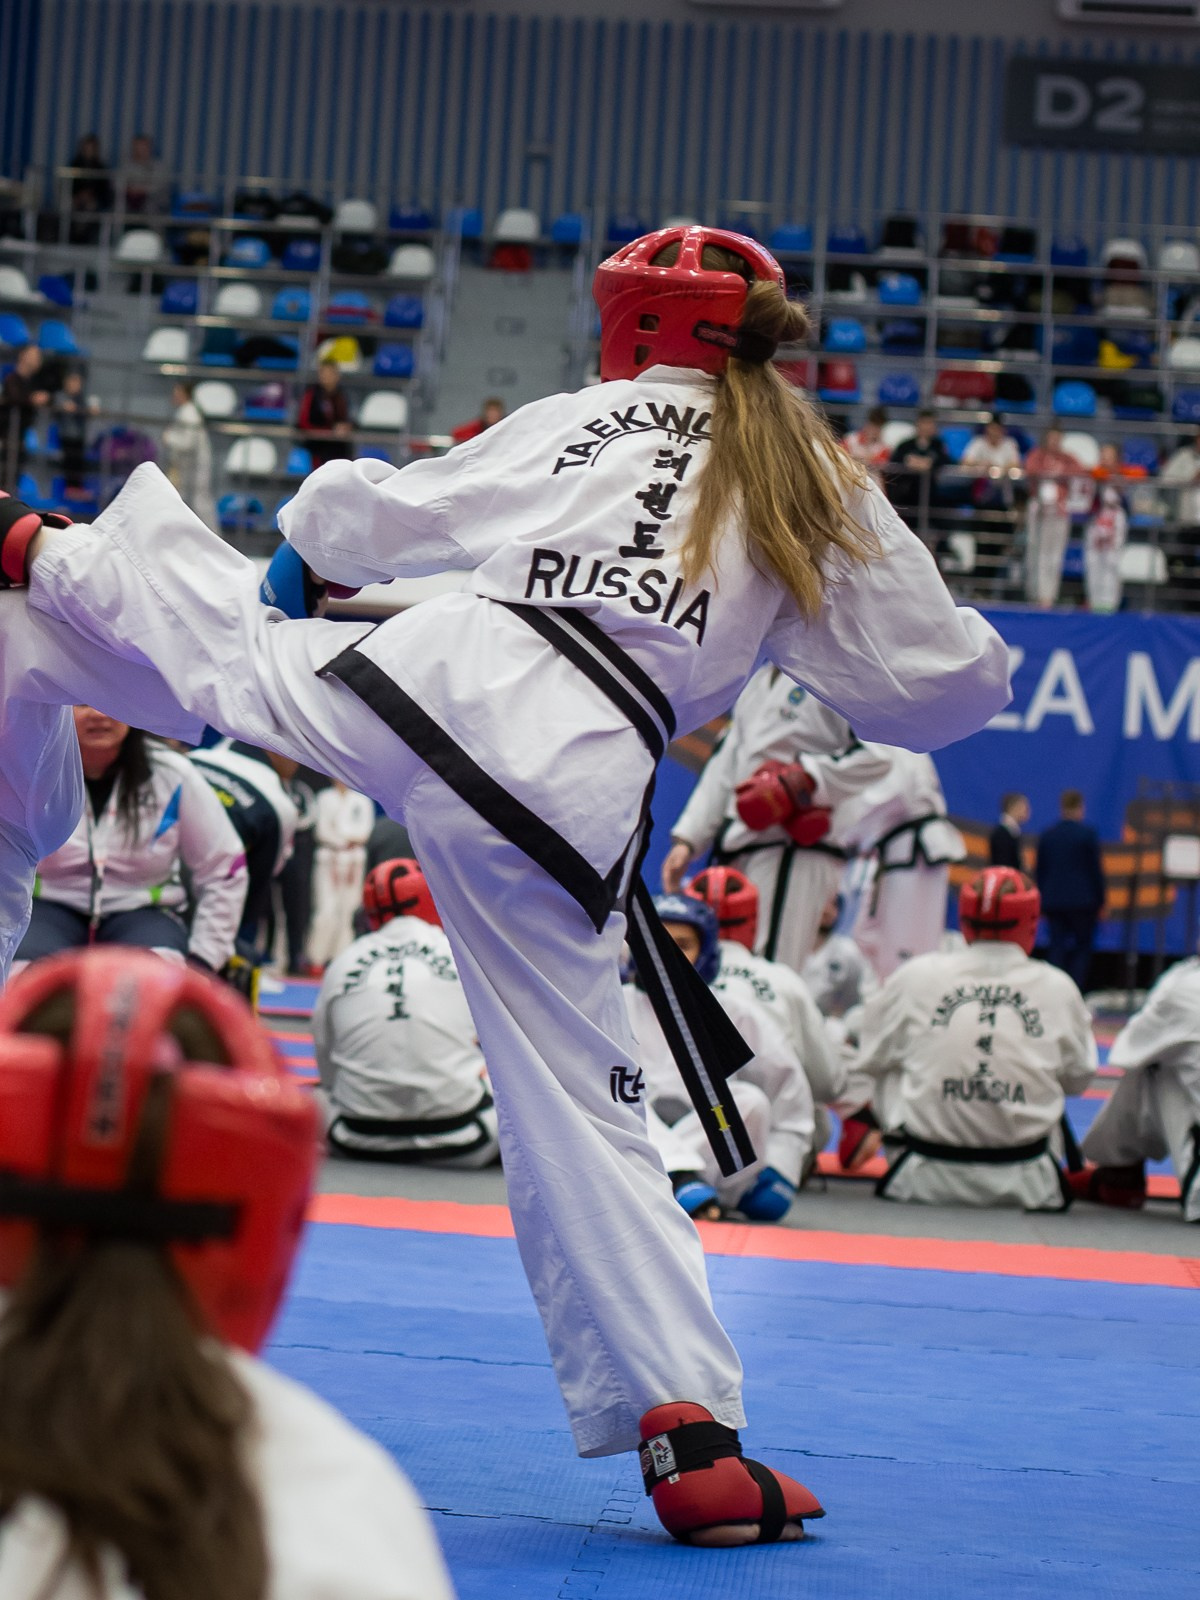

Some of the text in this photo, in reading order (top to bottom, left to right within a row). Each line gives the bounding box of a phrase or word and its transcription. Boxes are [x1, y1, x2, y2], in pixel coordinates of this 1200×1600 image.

[1035, 74, 1145, 131] D2
[551, 402, 714, 475] TAEKWO
[524, 547, 712, 647] RUSSIA
